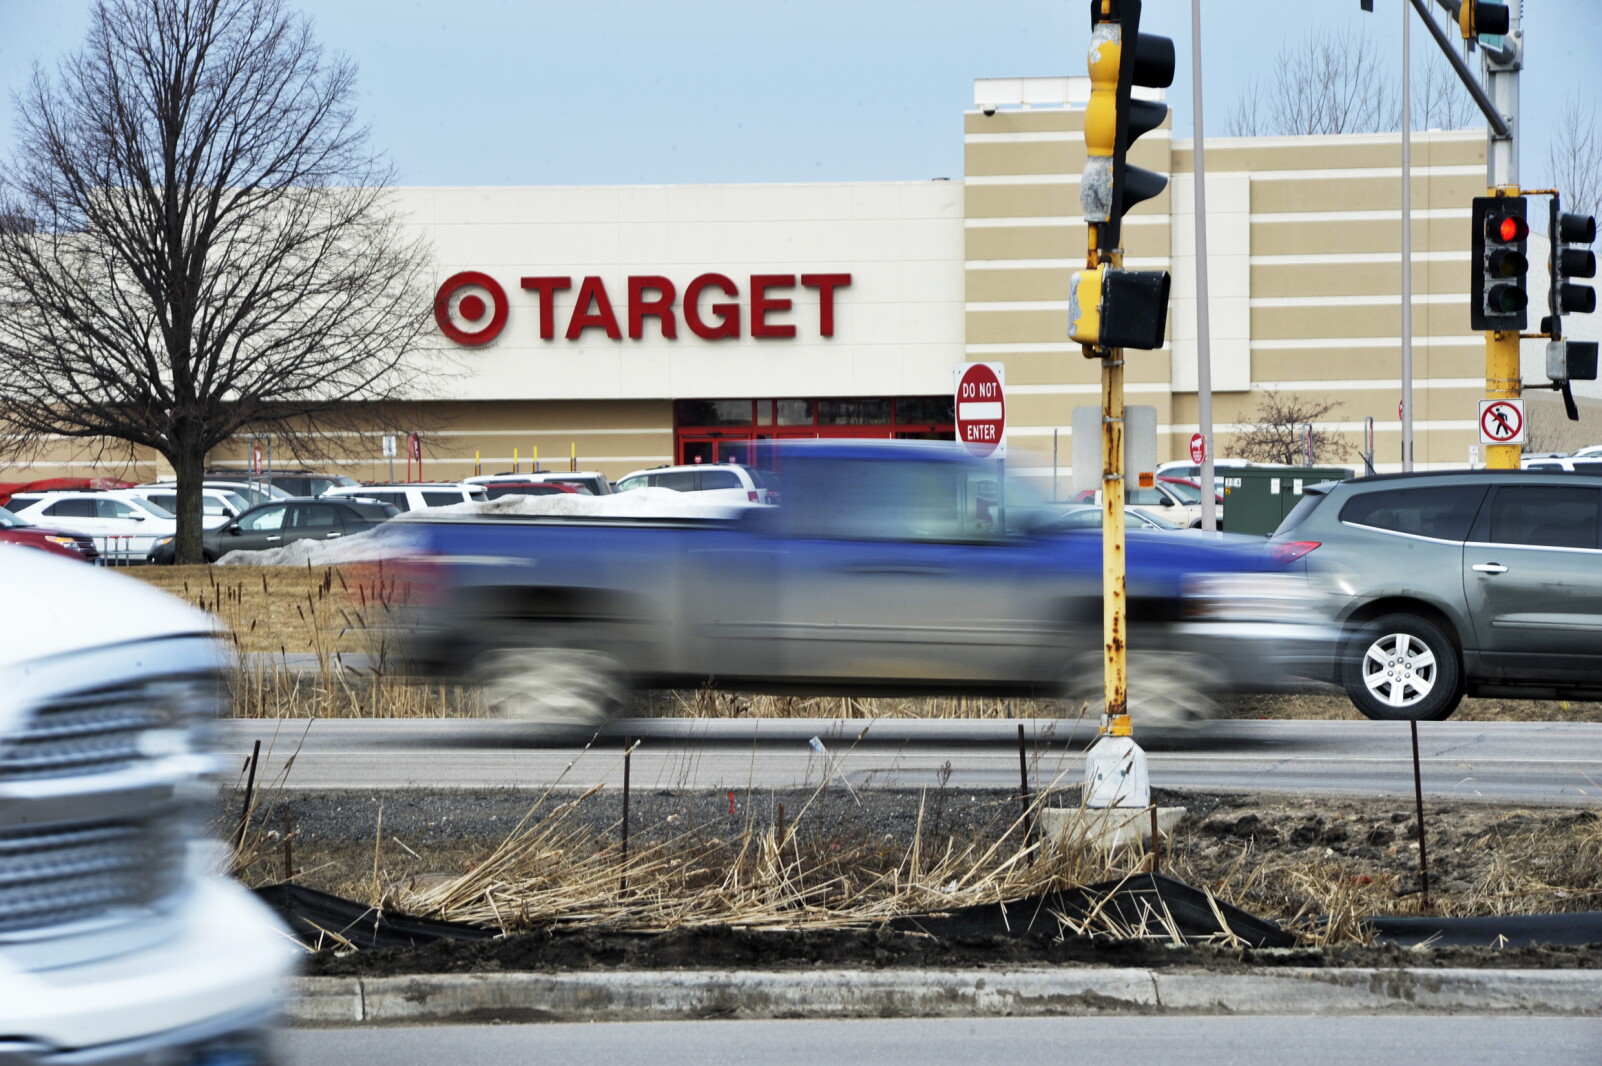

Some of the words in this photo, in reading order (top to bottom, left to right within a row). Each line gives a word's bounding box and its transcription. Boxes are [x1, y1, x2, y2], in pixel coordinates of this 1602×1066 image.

[520, 272, 853, 341] TARGET
[962, 382, 976, 398] DO
[979, 382, 997, 398] NOT
[967, 424, 996, 440] ENTER
